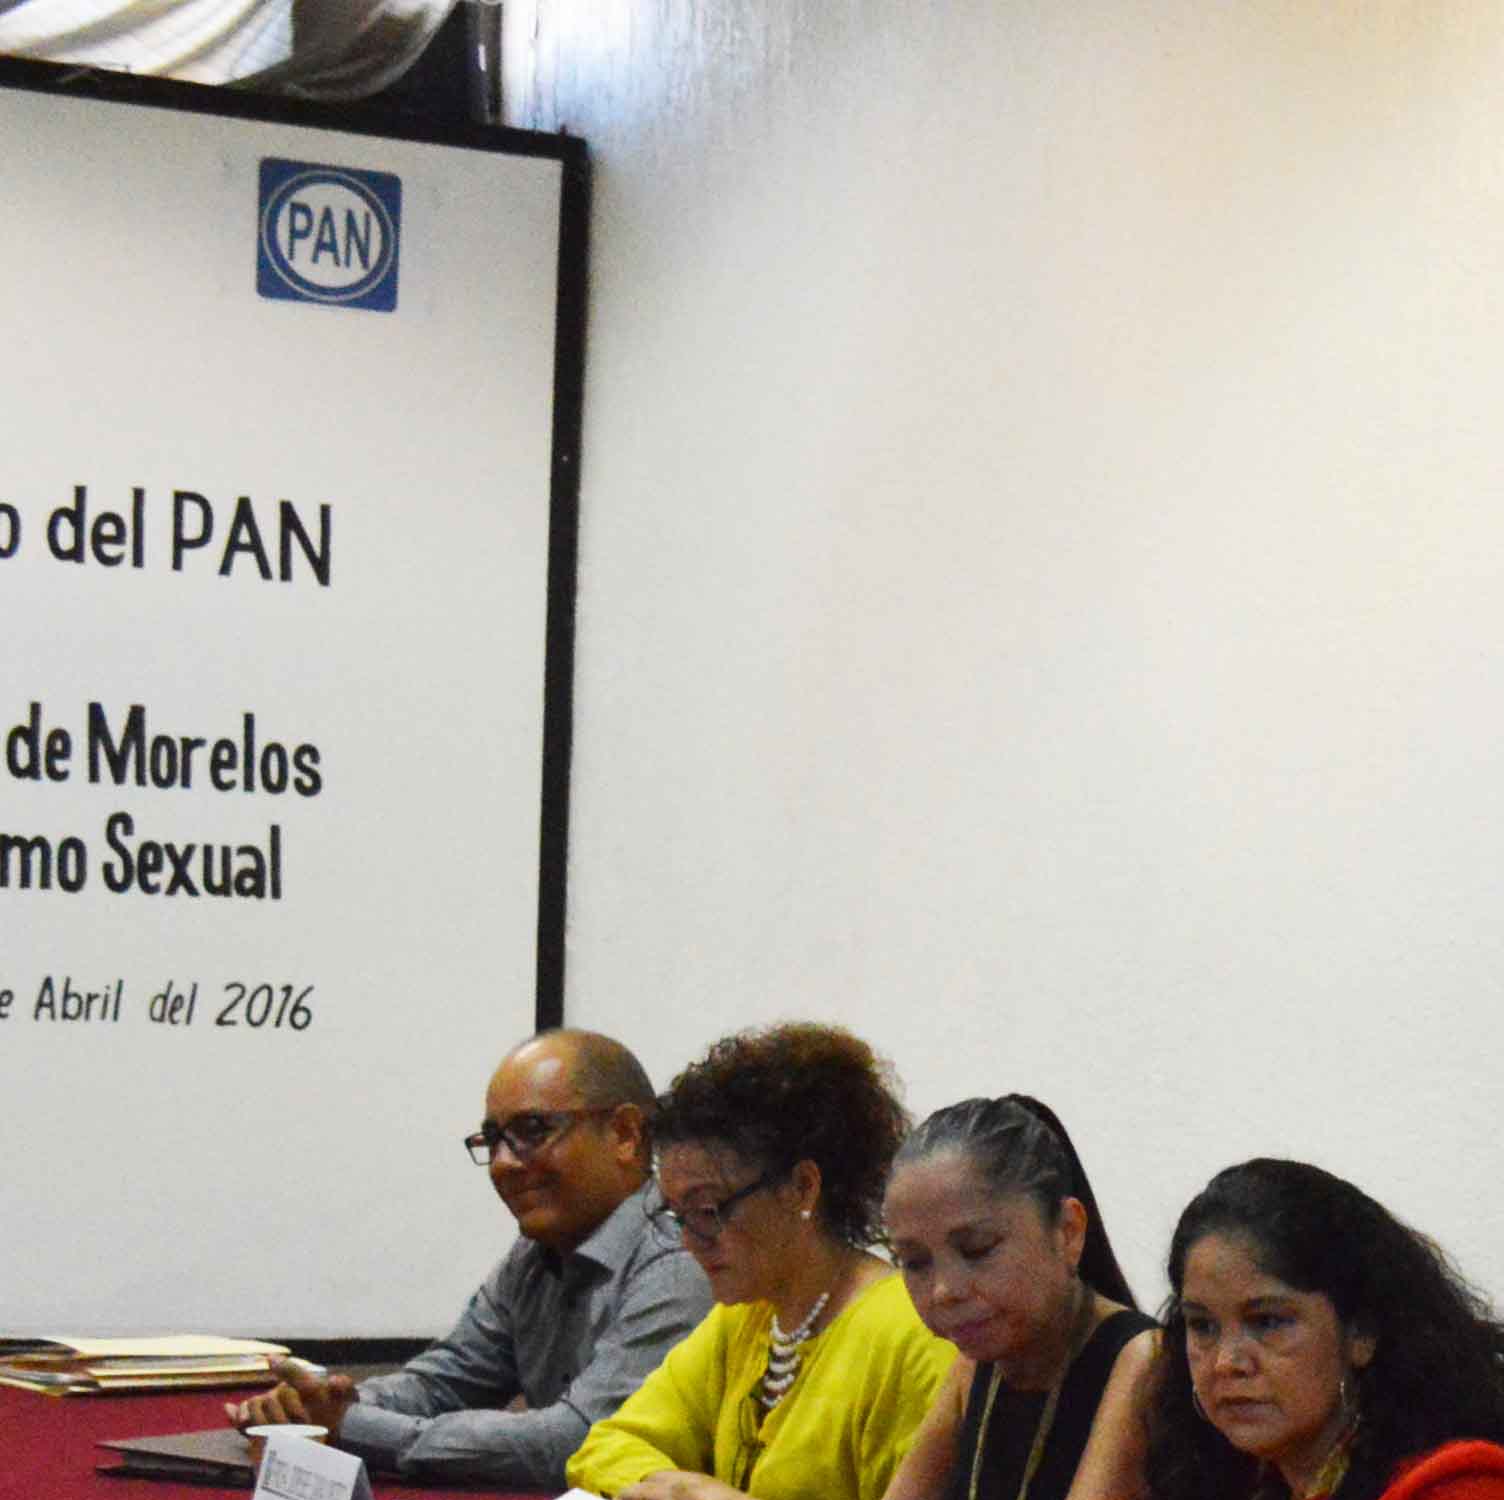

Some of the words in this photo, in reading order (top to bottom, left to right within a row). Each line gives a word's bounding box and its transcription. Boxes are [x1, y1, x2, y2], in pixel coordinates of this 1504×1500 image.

[288, 202, 372, 270] PAN
[47, 485, 145, 569] del
[172, 490, 331, 587] PAN
[7, 701, 72, 782] de
[88, 701, 322, 797] Morelos
[102, 811, 282, 900] Sexual
[33, 975, 123, 1023] Abril
[149, 979, 198, 1027] del
[215, 982, 314, 1031] 2016
